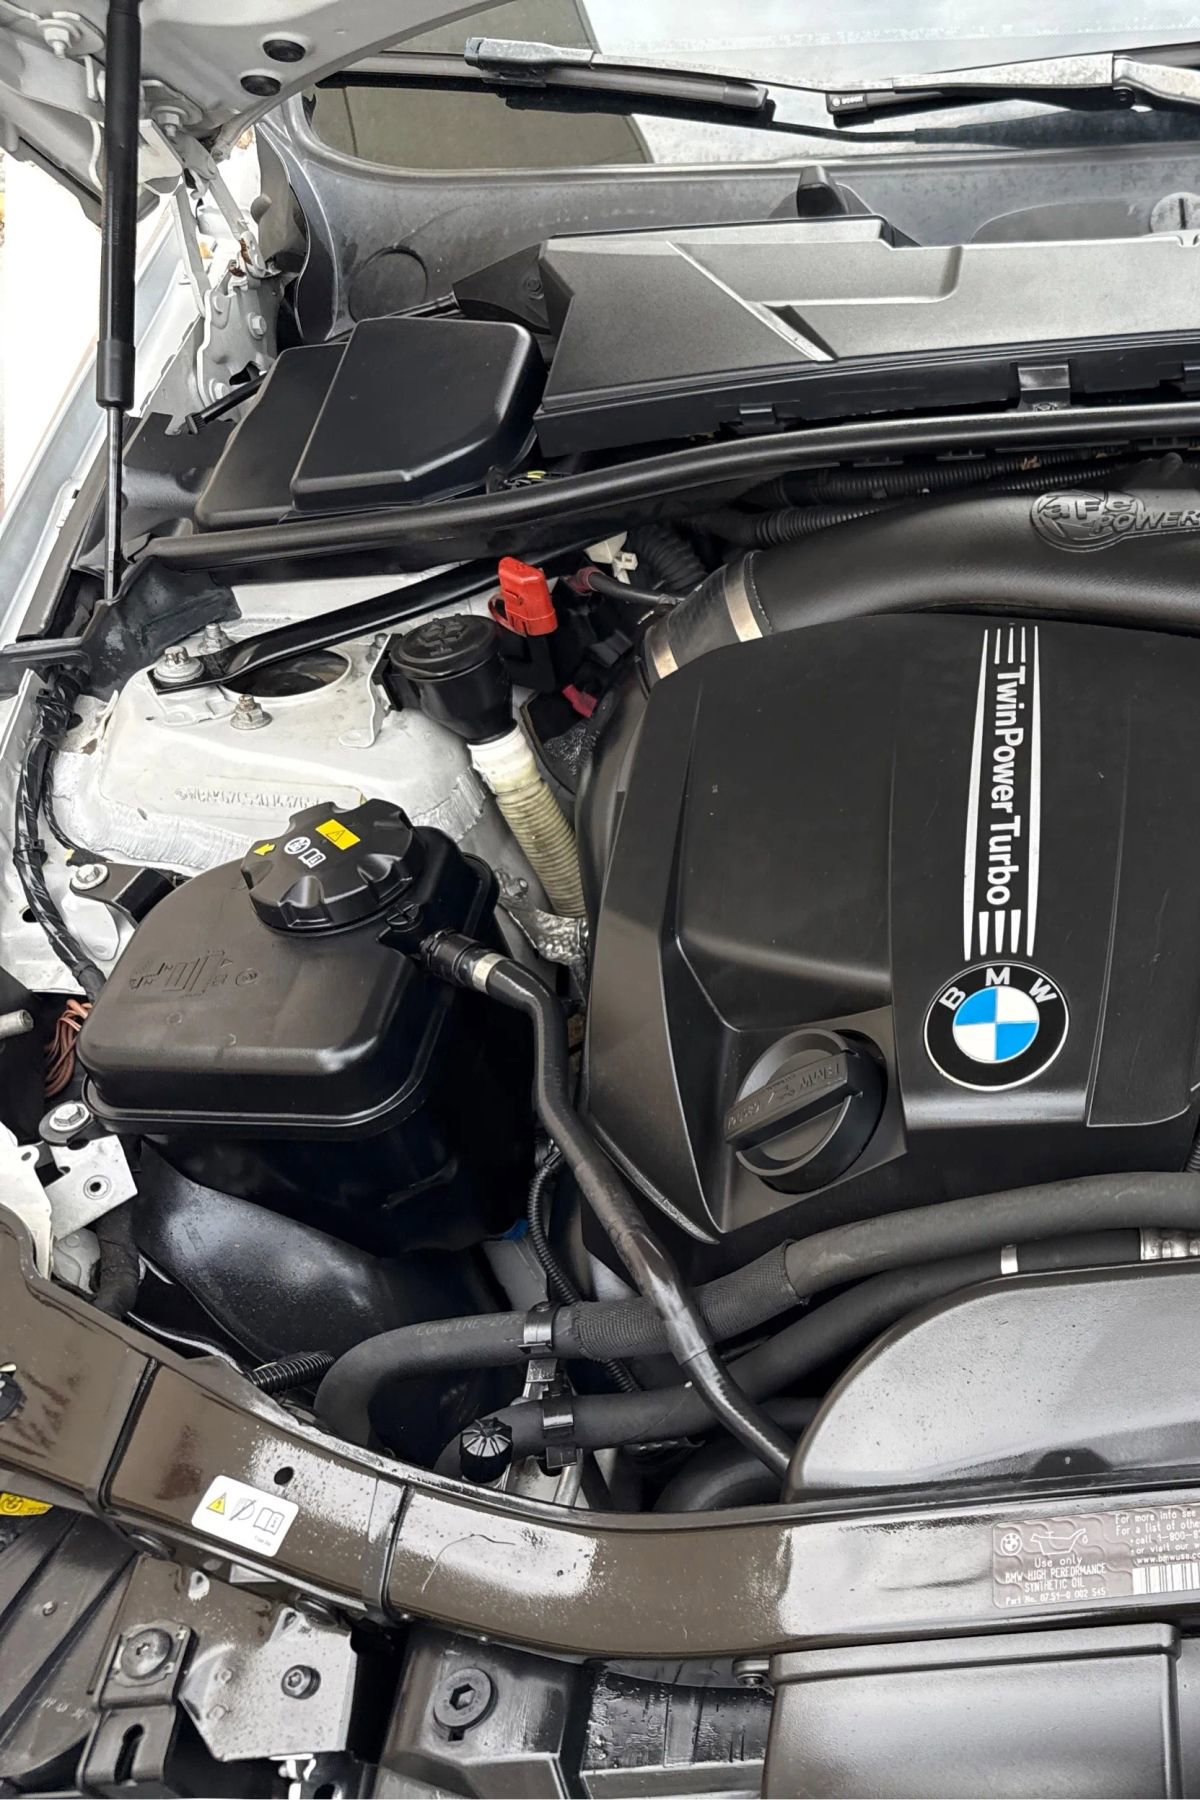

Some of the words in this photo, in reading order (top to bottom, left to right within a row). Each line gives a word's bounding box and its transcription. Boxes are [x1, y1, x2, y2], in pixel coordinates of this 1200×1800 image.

[991, 665, 1026, 813] TwinPower
[986, 815, 1021, 906] Turbo
[1115, 1513, 1130, 1525] For
[1134, 1513, 1155, 1522] more
[1160, 1508, 1177, 1520] info
[1182, 1510, 1197, 1518] see
[1115, 1524, 1130, 1536] For
[1135, 1526, 1141, 1534] a
[1145, 1521, 1161, 1533] list
[1166, 1519, 1175, 1531] of
[1150, 1542, 1170, 1553] visit
[1175, 1543, 1189, 1551] our
[1034, 1557, 1053, 1569] Use
[1059, 1553, 1083, 1567] only
[1005, 1570, 1024, 1584] BMW
[1027, 1569, 1047, 1581] HIGH
[1024, 1578, 1068, 1593] SYNTHETIC
[1071, 1576, 1086, 1588] OIL
